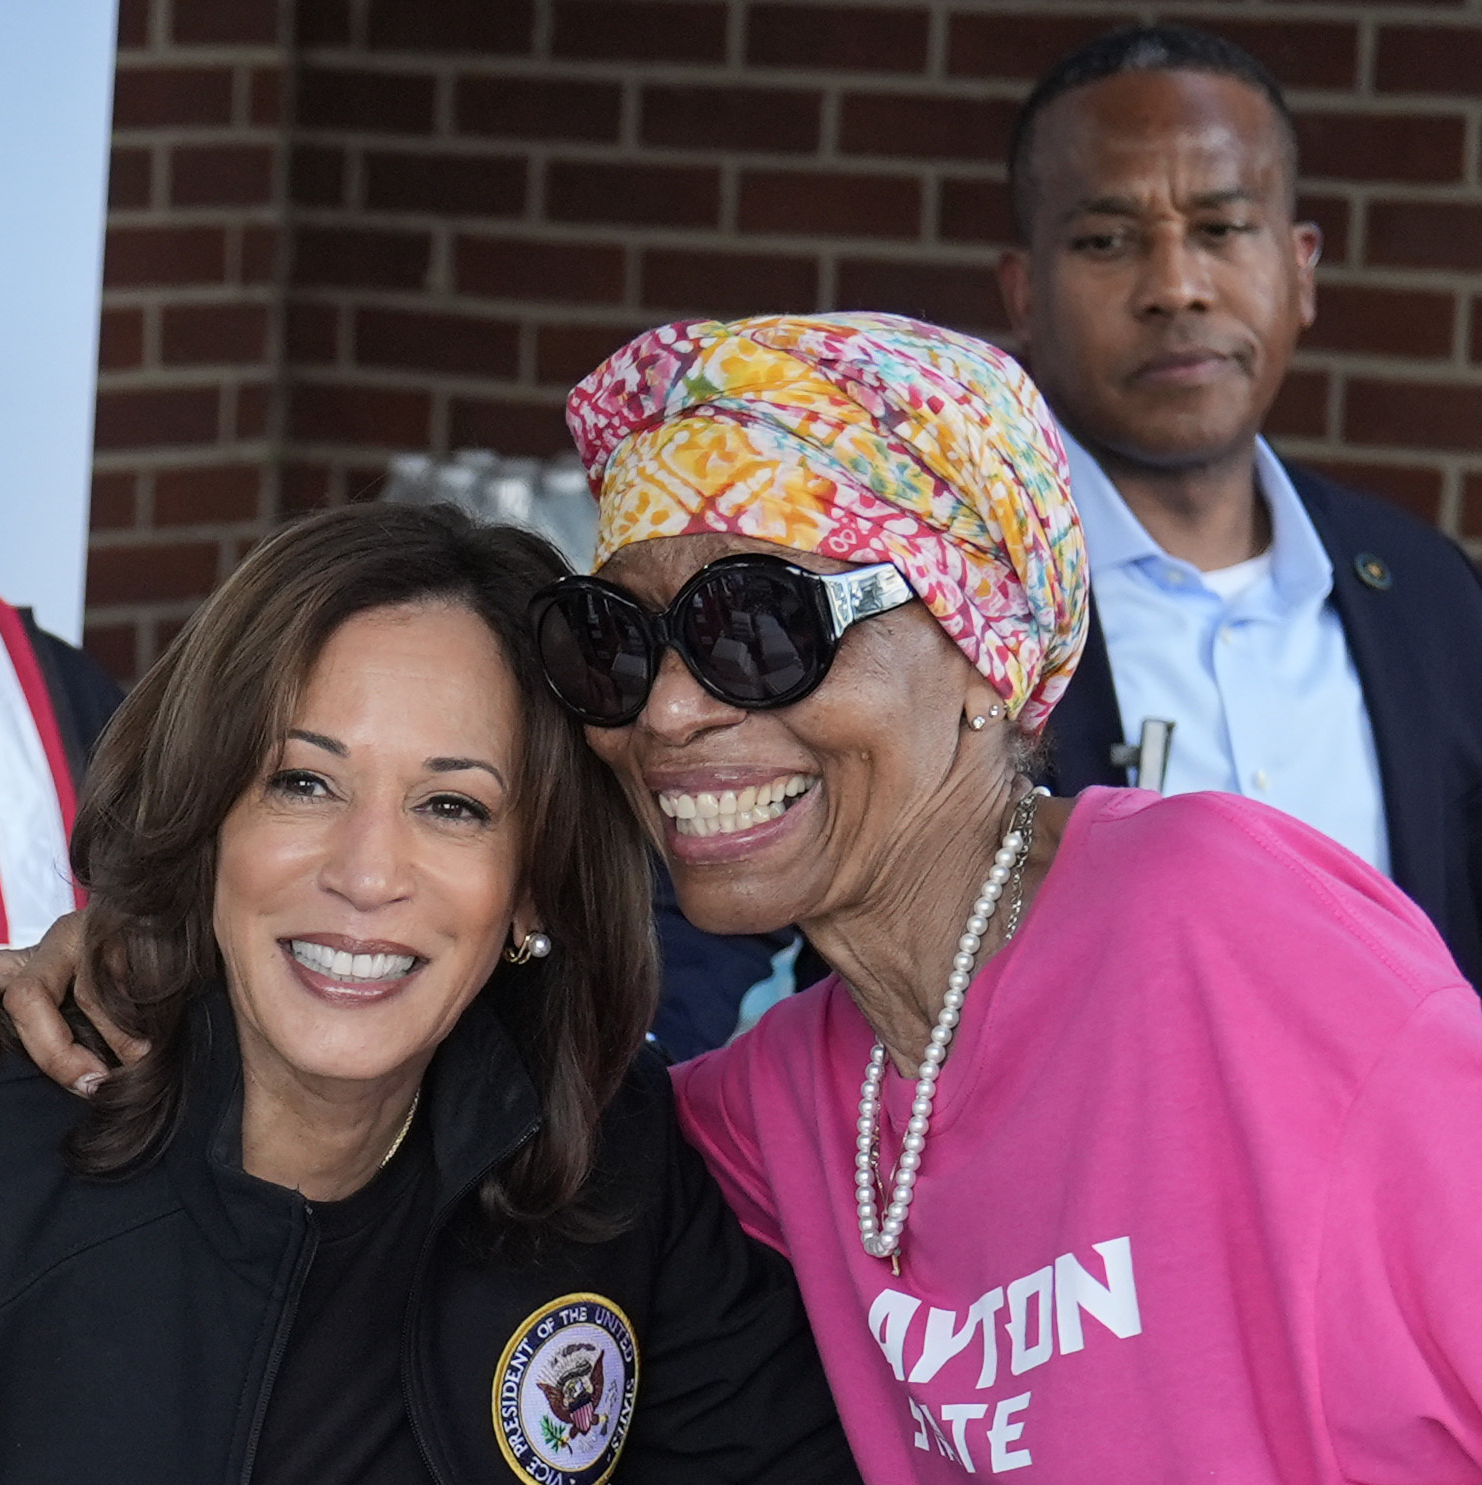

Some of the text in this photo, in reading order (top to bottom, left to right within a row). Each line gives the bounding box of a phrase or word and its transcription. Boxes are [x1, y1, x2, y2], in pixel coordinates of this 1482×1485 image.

[536, 1317, 556, 1340] OF
[559, 1306, 588, 1326] THE
[594, 1308, 635, 1364] UNITED
[500, 1337, 535, 1459] PRESIDENT
[610, 1376, 636, 1454] STATES
